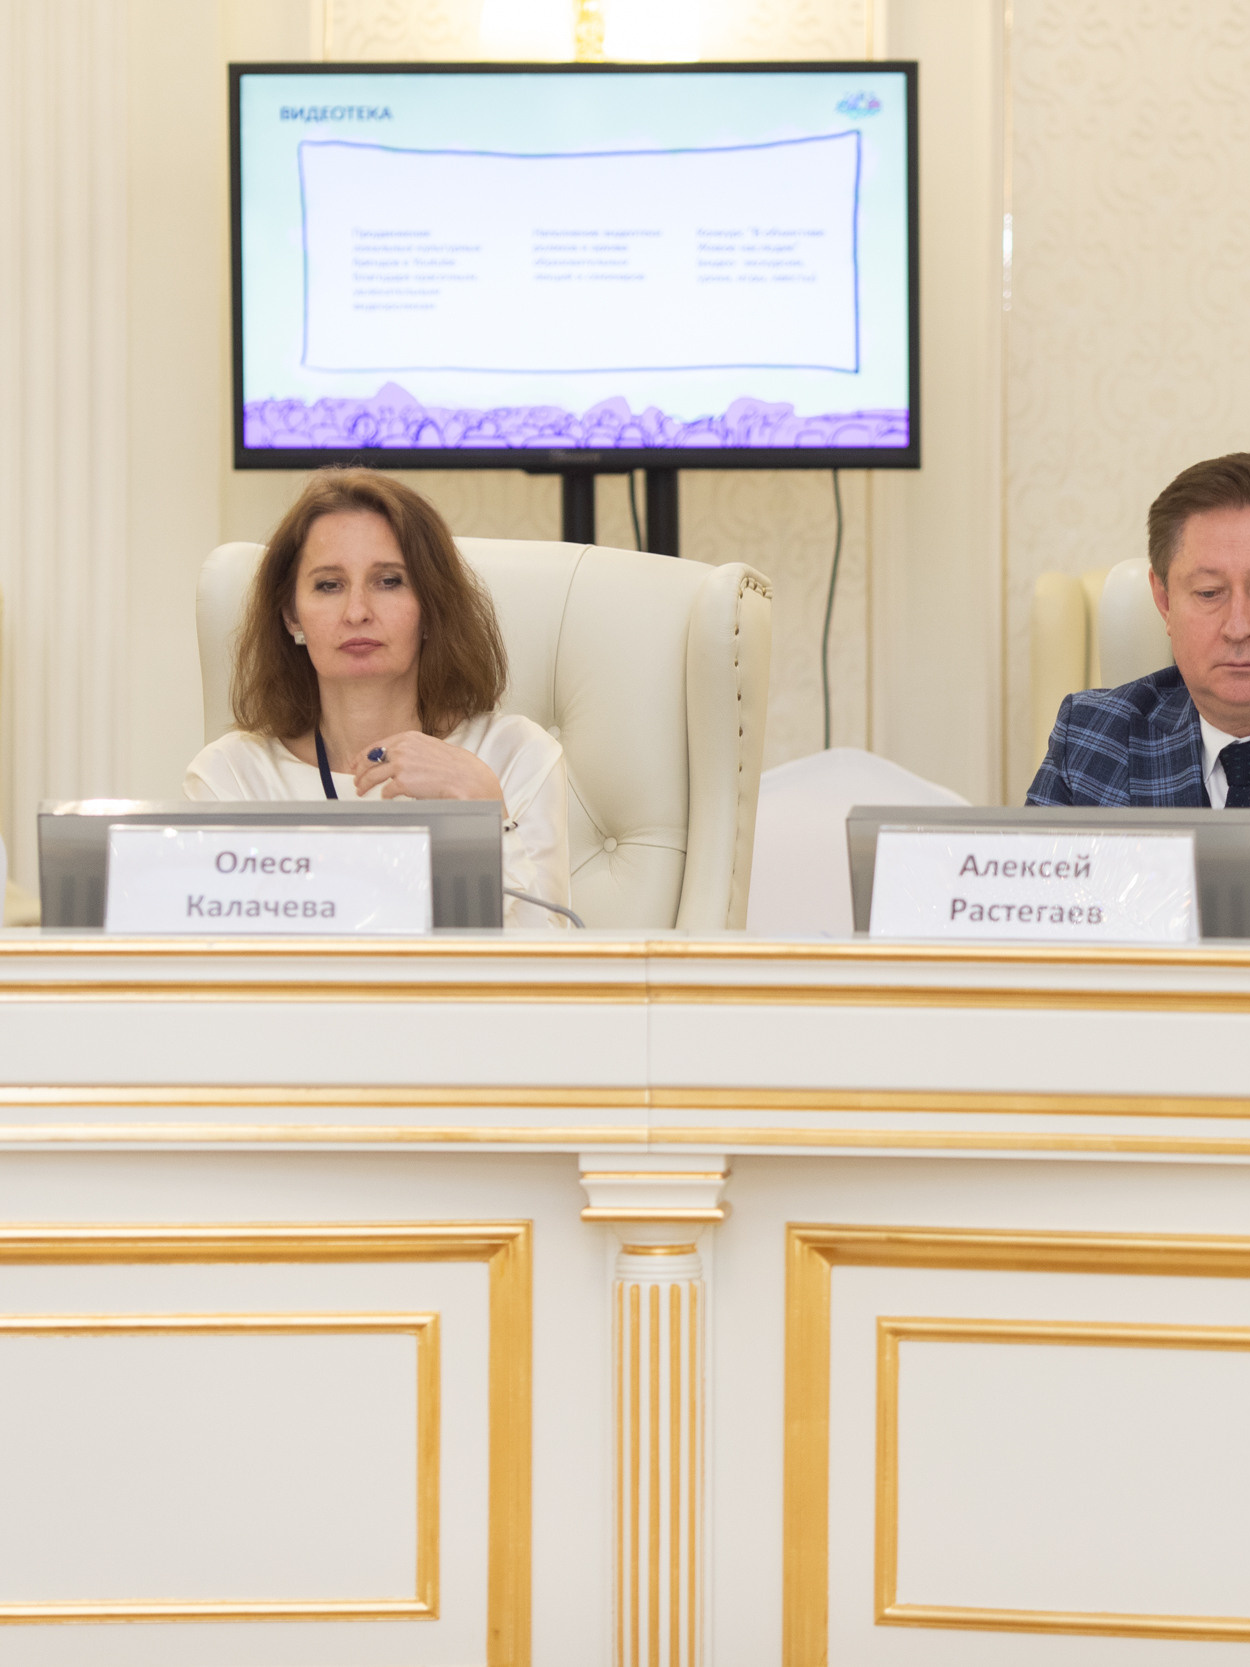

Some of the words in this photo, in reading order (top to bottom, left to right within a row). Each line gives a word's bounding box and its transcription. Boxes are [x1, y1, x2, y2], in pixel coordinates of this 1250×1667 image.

[279, 105, 392, 122] ВИДЕОТЕКА
[214, 850, 311, 875] Олеся
[958, 853, 1091, 879] Алексей
[186, 894, 336, 919] Калачева
[949, 897, 1102, 925] Растегаев
